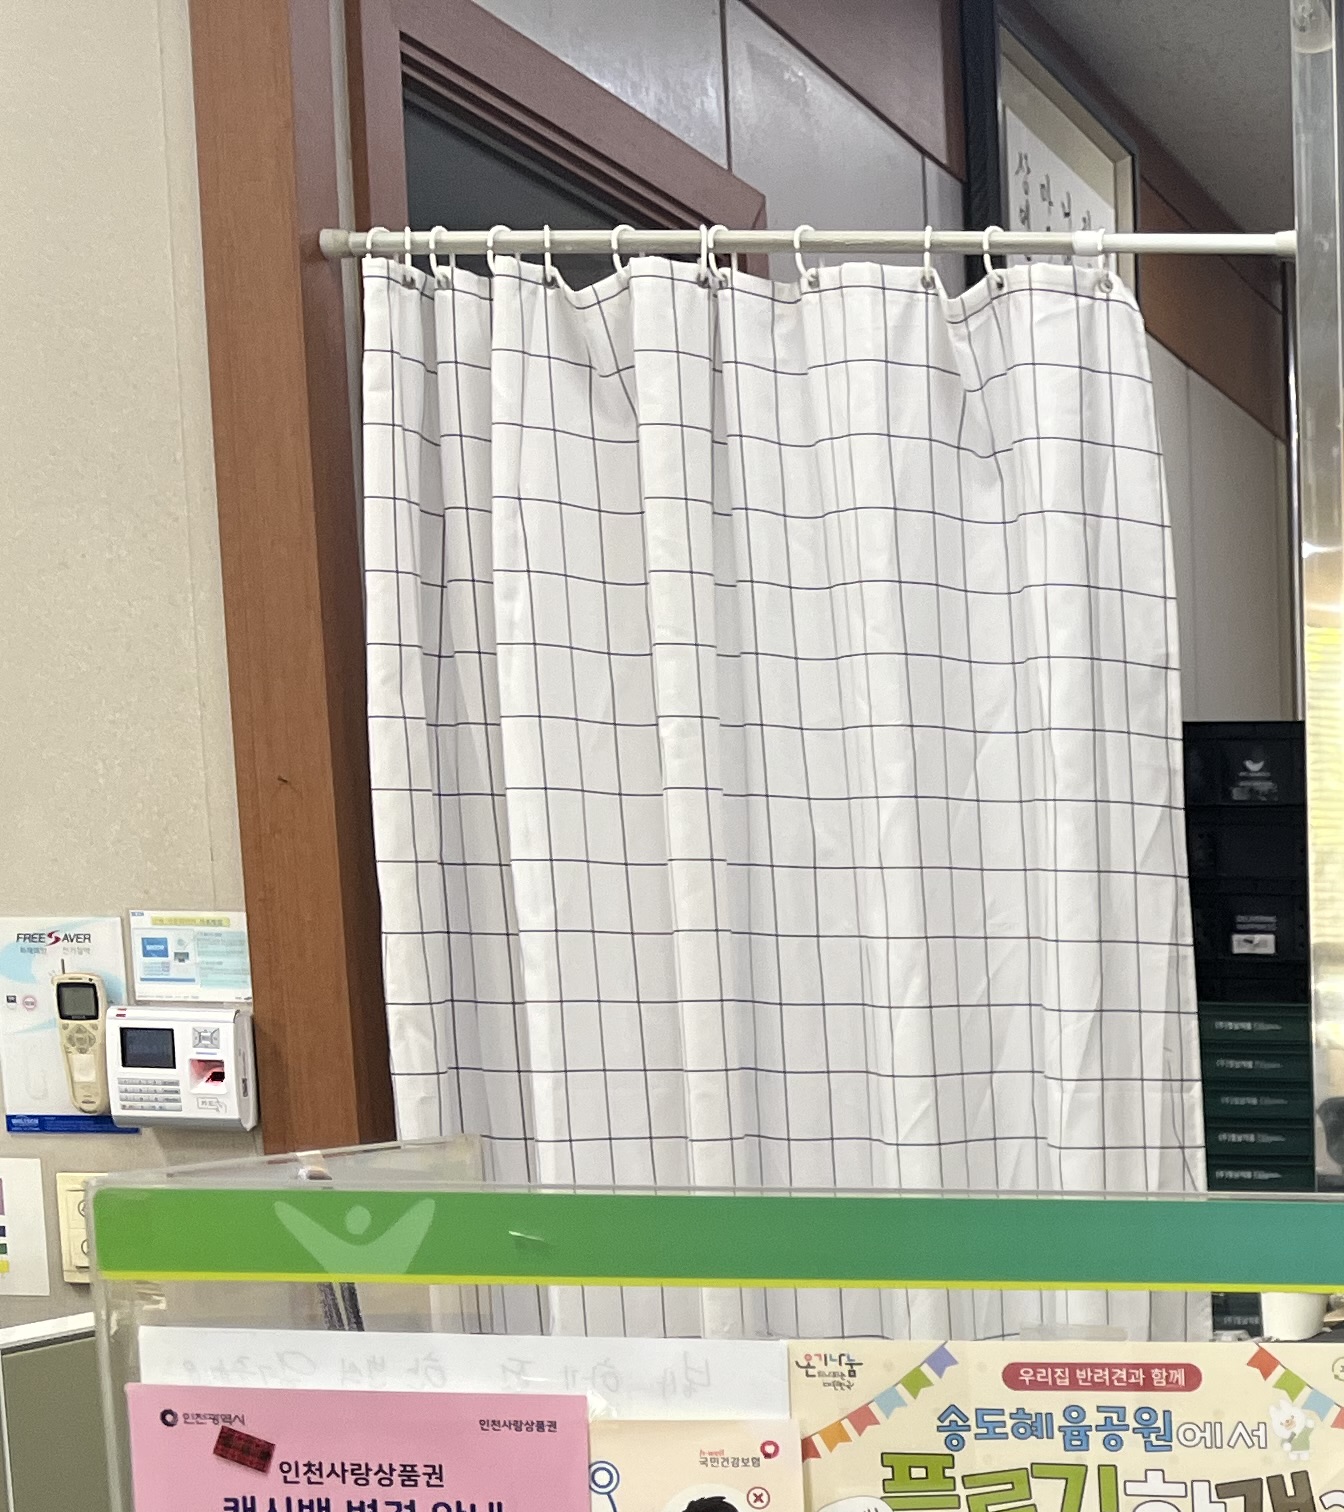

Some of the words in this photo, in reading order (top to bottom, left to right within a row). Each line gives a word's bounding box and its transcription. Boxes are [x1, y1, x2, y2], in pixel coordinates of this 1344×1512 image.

[1018, 1367, 1071, 1387] 우리집
[1074, 1367, 1145, 1387] 반려견과
[1148, 1367, 1186, 1387] 함께
[479, 1419, 558, 1433] 인천사랑상품권
[936, 1403, 1268, 1453] 송도혜윰공원에서
[699, 1457, 760, 1467] 국민건강보험
[279, 1461, 444, 1488] 인천사랑상품권
